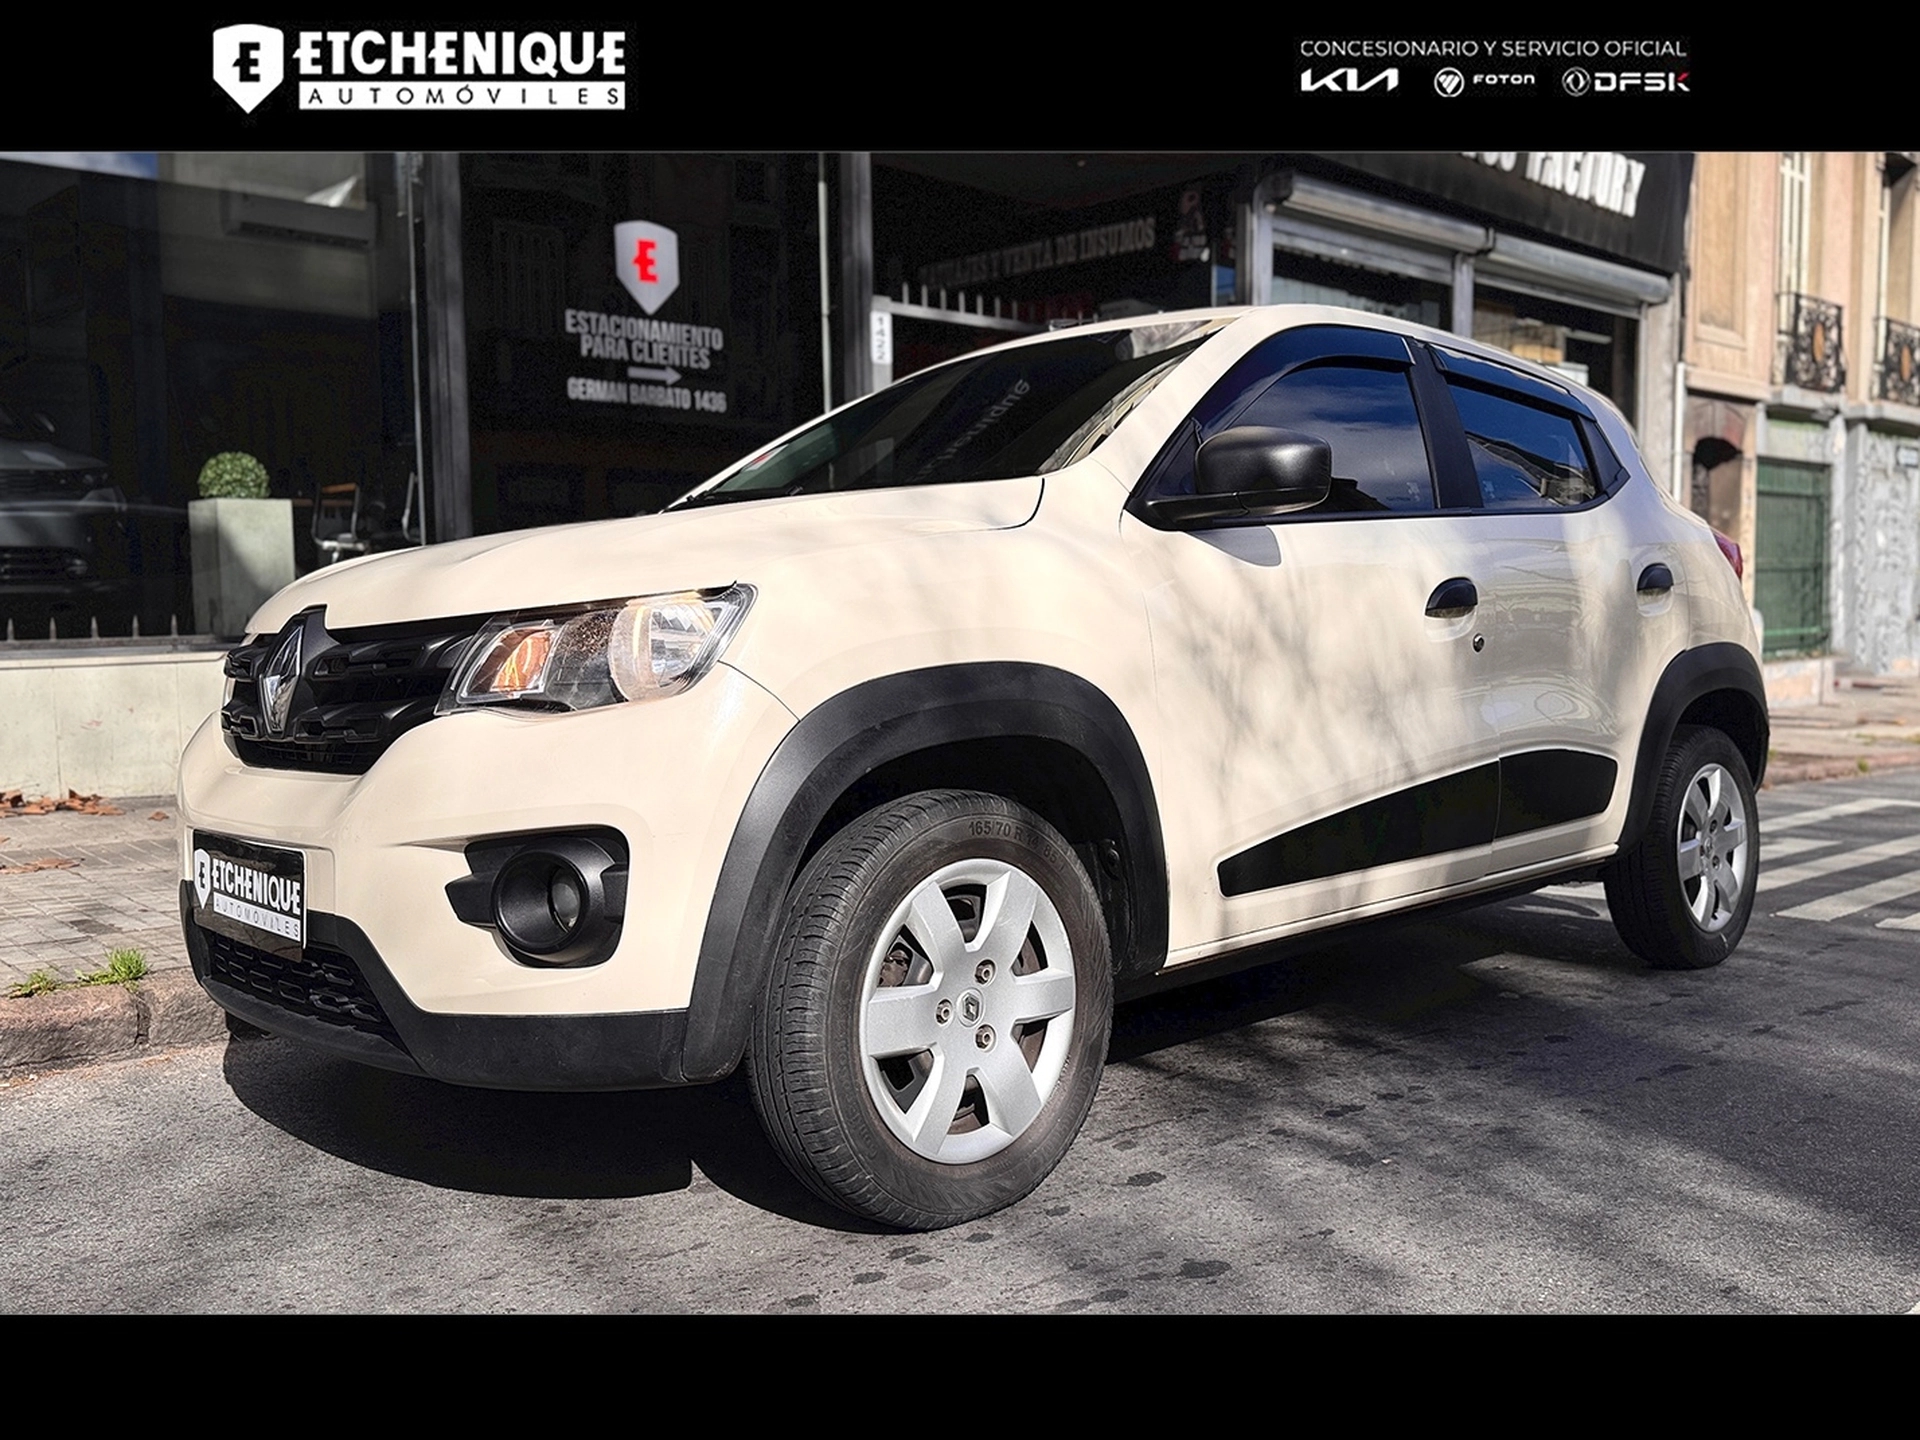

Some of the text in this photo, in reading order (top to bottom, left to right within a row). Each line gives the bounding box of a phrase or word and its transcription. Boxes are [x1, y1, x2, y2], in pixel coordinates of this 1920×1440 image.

[1055, 234, 1077, 265] DE
[1079, 216, 1156, 261] INSUMOS
[565, 308, 724, 351] ESTACIONAMIENTO
[580, 334, 711, 370] PARA CLIENTES
[567, 376, 727, 413] GERMAN BARBATO 1436
[211, 858, 301, 916] ETCHENIQUE
